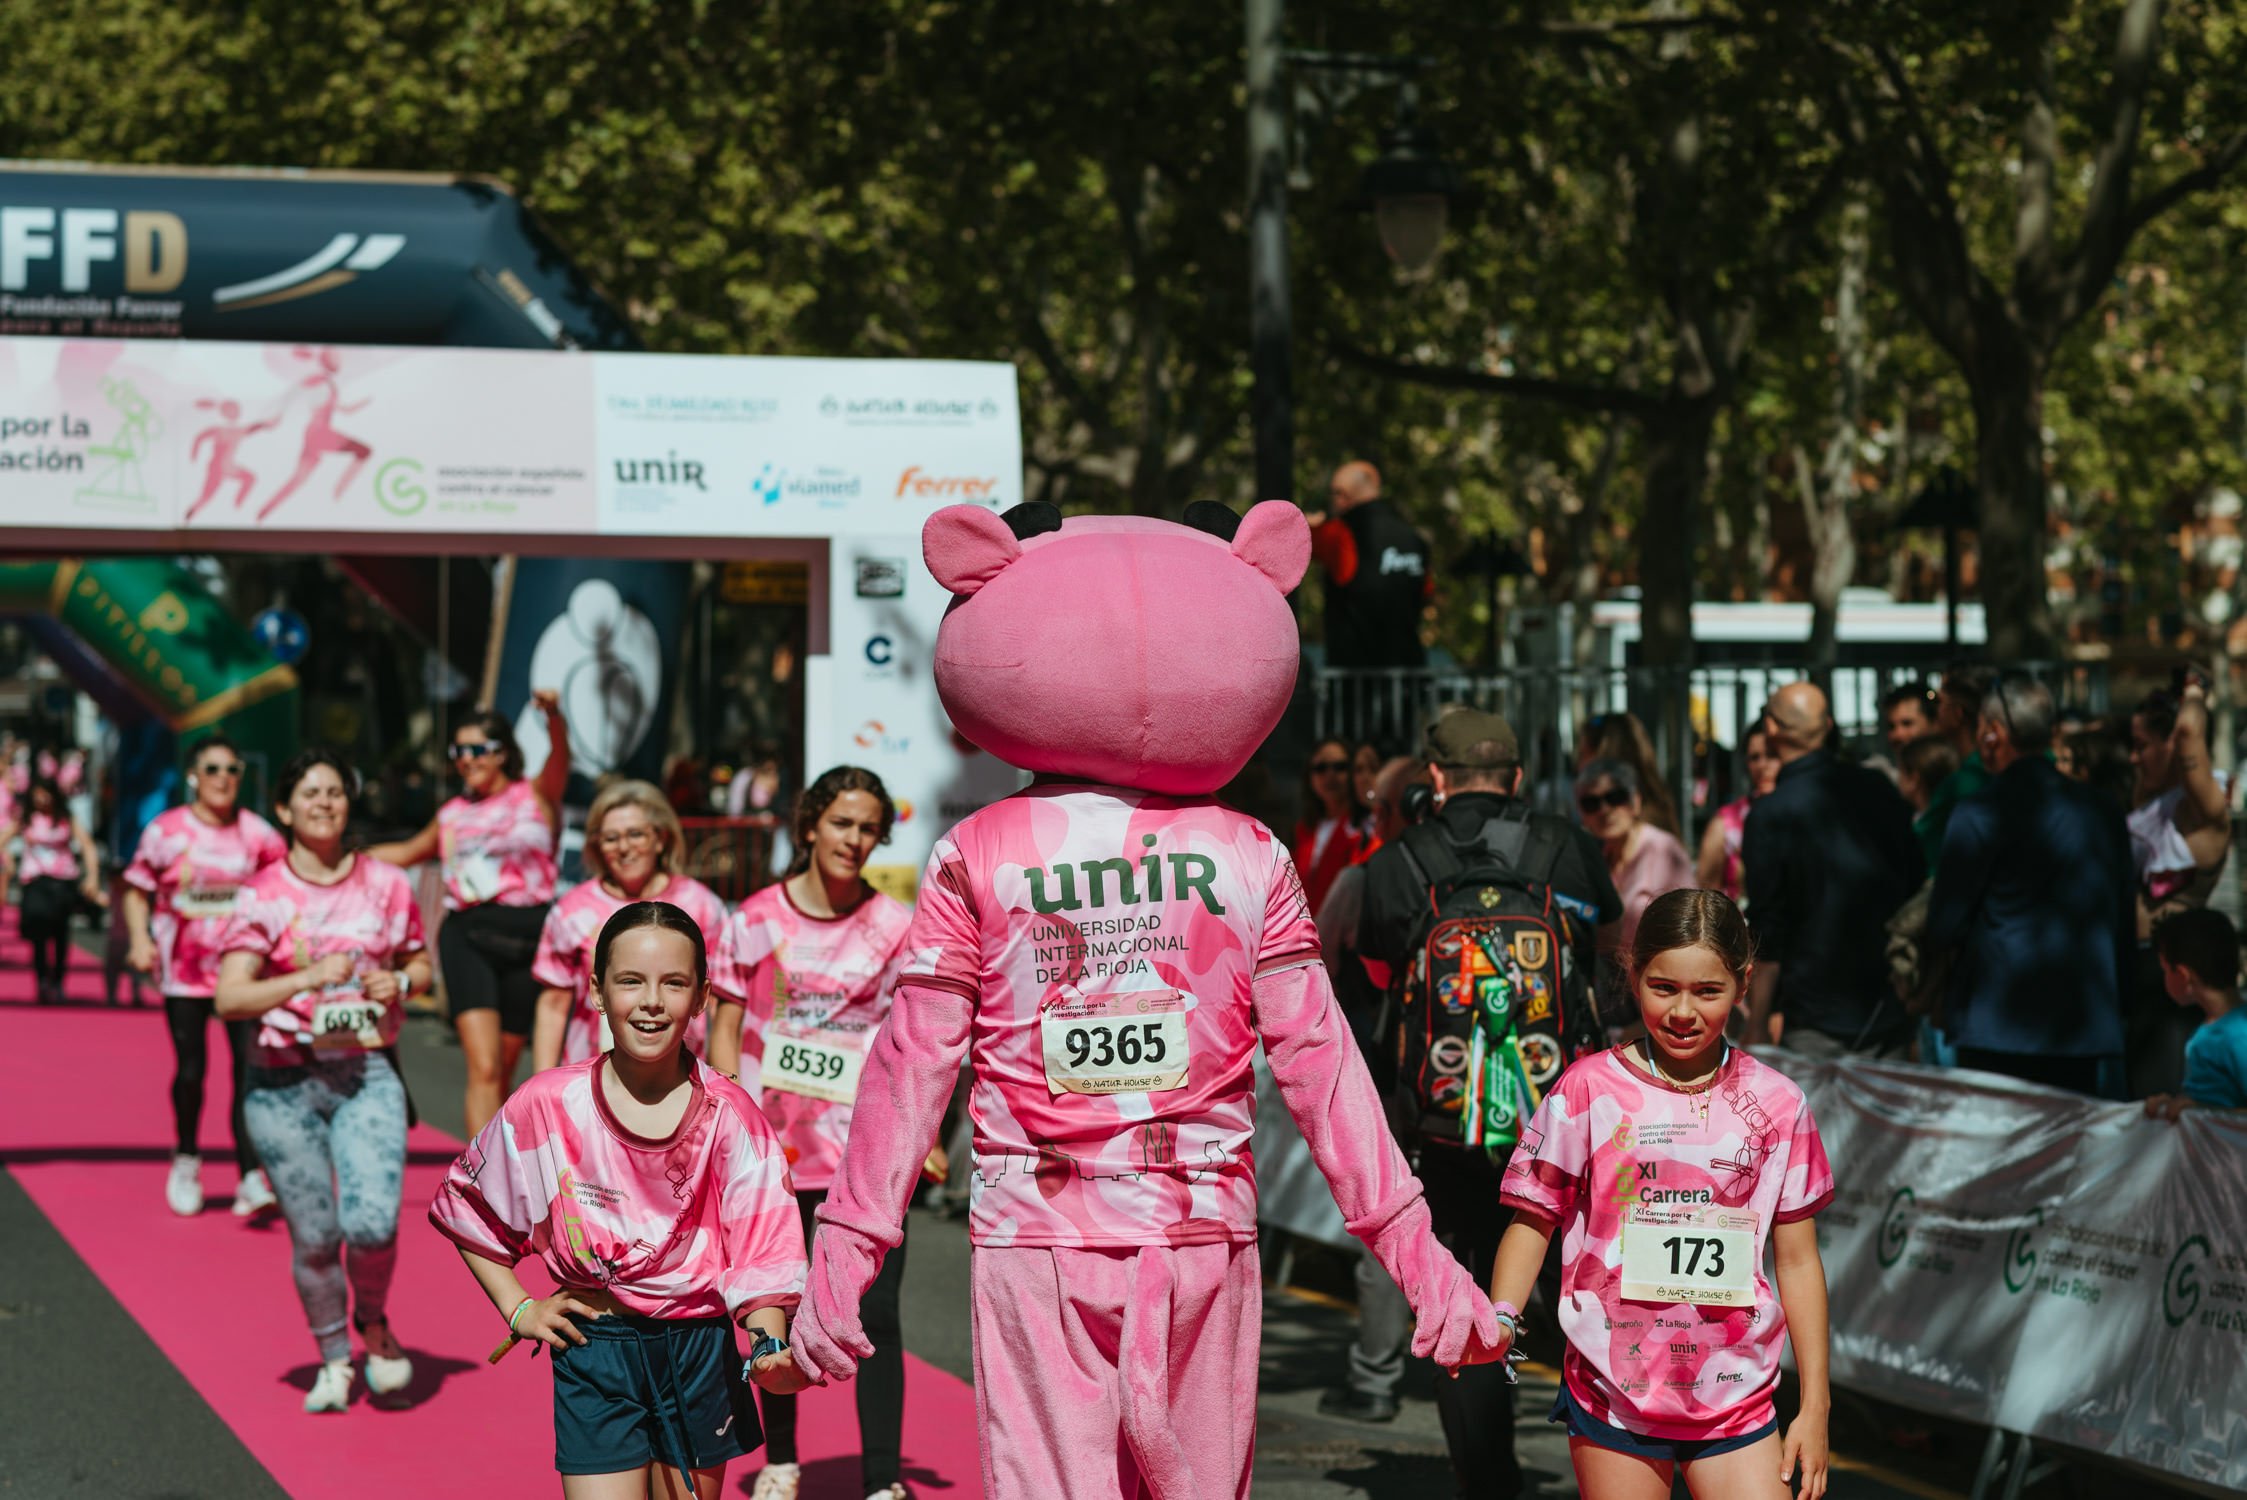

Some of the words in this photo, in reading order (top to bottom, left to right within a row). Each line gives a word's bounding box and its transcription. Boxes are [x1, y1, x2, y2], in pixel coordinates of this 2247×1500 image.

[0, 206, 189, 293] FFD
[1, 417, 52, 442] por
[62, 412, 90, 438] la
[1033, 915, 1161, 941] UNIVERSIDAD
[1034, 935, 1189, 963] INTERNACIONAL
[1036, 967, 1061, 983] DE
[1067, 966, 1091, 981] LA
[1097, 959, 1148, 977] RIOJA
[1051, 1010, 1095, 1018] investigación
[1061, 1003, 1086, 1011] Carrera
[1087, 1002, 1098, 1010] por
[1066, 1023, 1166, 1068] 9365
[779, 1044, 844, 1080] 8539
[1093, 1079, 1122, 1088] NATUR
[1124, 1078, 1151, 1087] HOUSE
[1637, 1162, 1657, 1180] XI
[590, 1199, 606, 1209] Rioja
[1640, 1186, 1710, 1203] Carrera
[1662, 1237, 1725, 1277] 173
[2051, 1275, 2069, 1296] La
[1614, 1319, 1644, 1330] Logroño
[1665, 1319, 1674, 1328] La
[1674, 1320, 1692, 1329] Rioja
